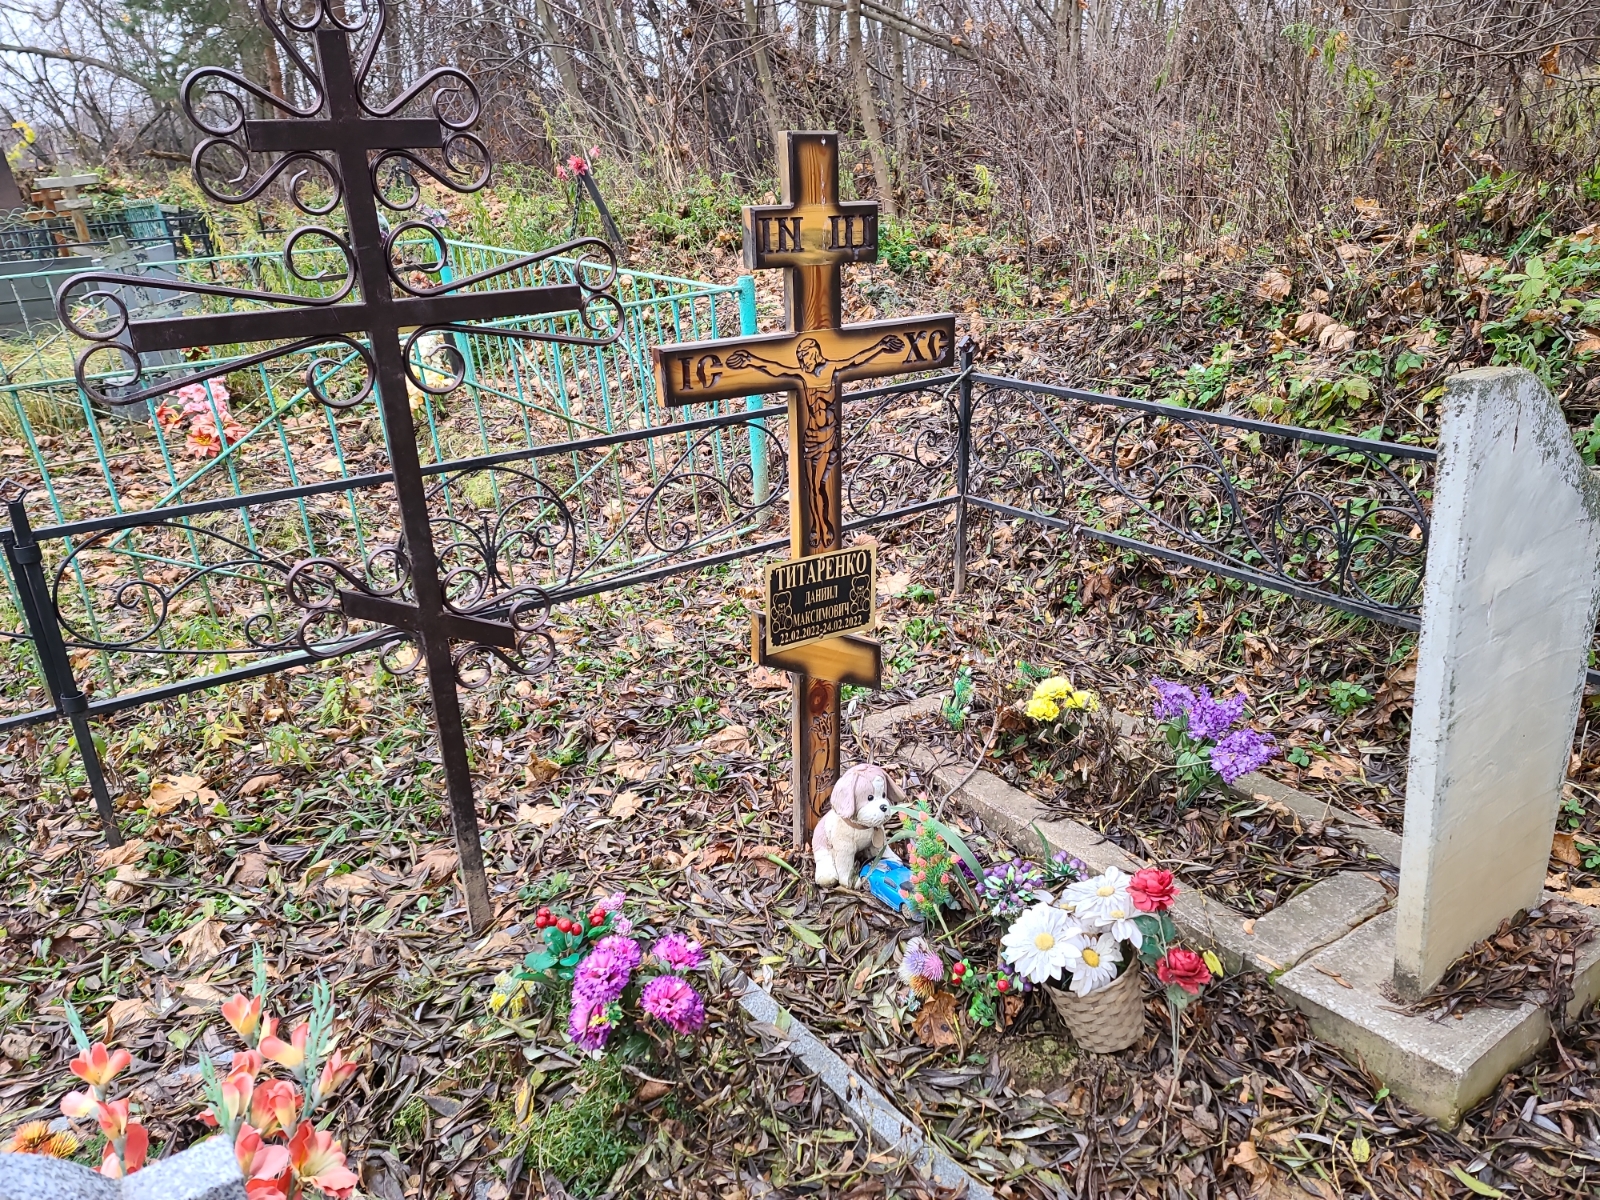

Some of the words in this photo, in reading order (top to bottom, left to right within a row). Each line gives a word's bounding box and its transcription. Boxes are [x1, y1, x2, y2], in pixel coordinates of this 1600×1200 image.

[776, 551, 867, 591] ТИТАРЕНКО
[805, 585, 839, 608] ДАНИИЛ
[792, 602, 850, 627] МАКСИМОВИЧ
[780, 615, 862, 644] 22.02.2022-24.02.2022
